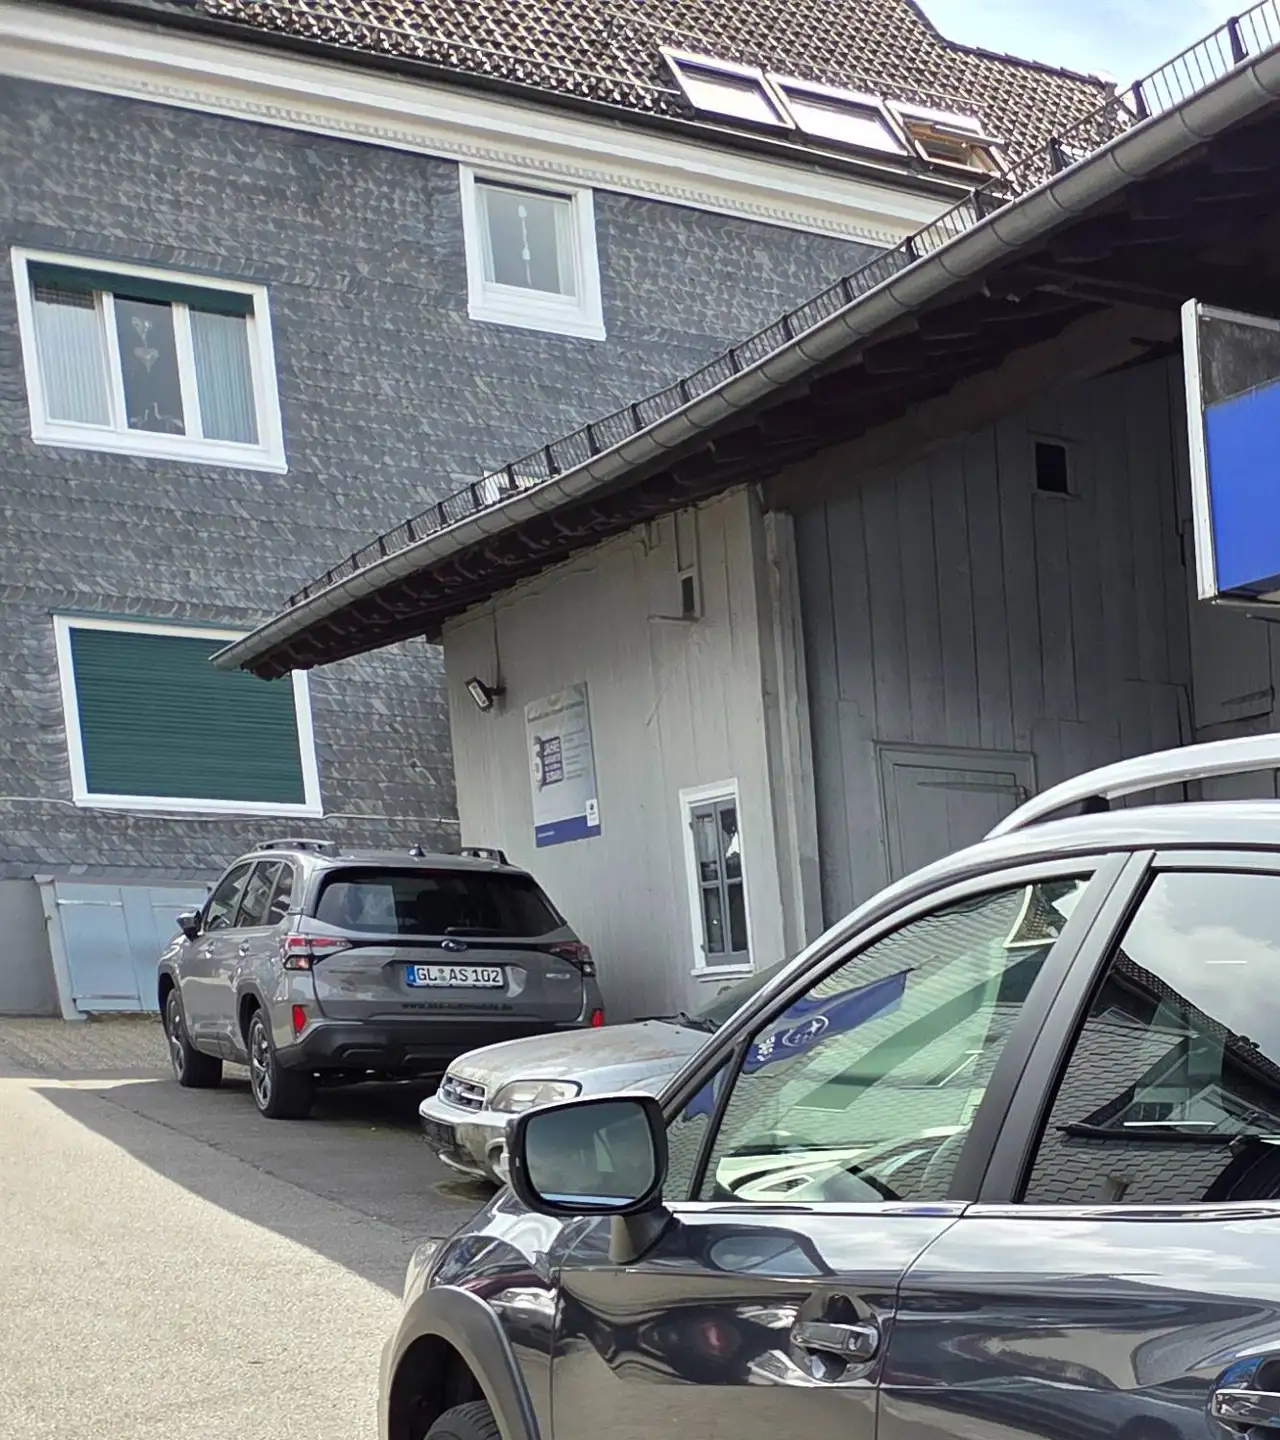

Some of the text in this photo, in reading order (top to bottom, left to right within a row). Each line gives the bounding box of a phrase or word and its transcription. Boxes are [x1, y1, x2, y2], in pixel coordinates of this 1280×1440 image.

[416, 967, 500, 984] GL AS 102
